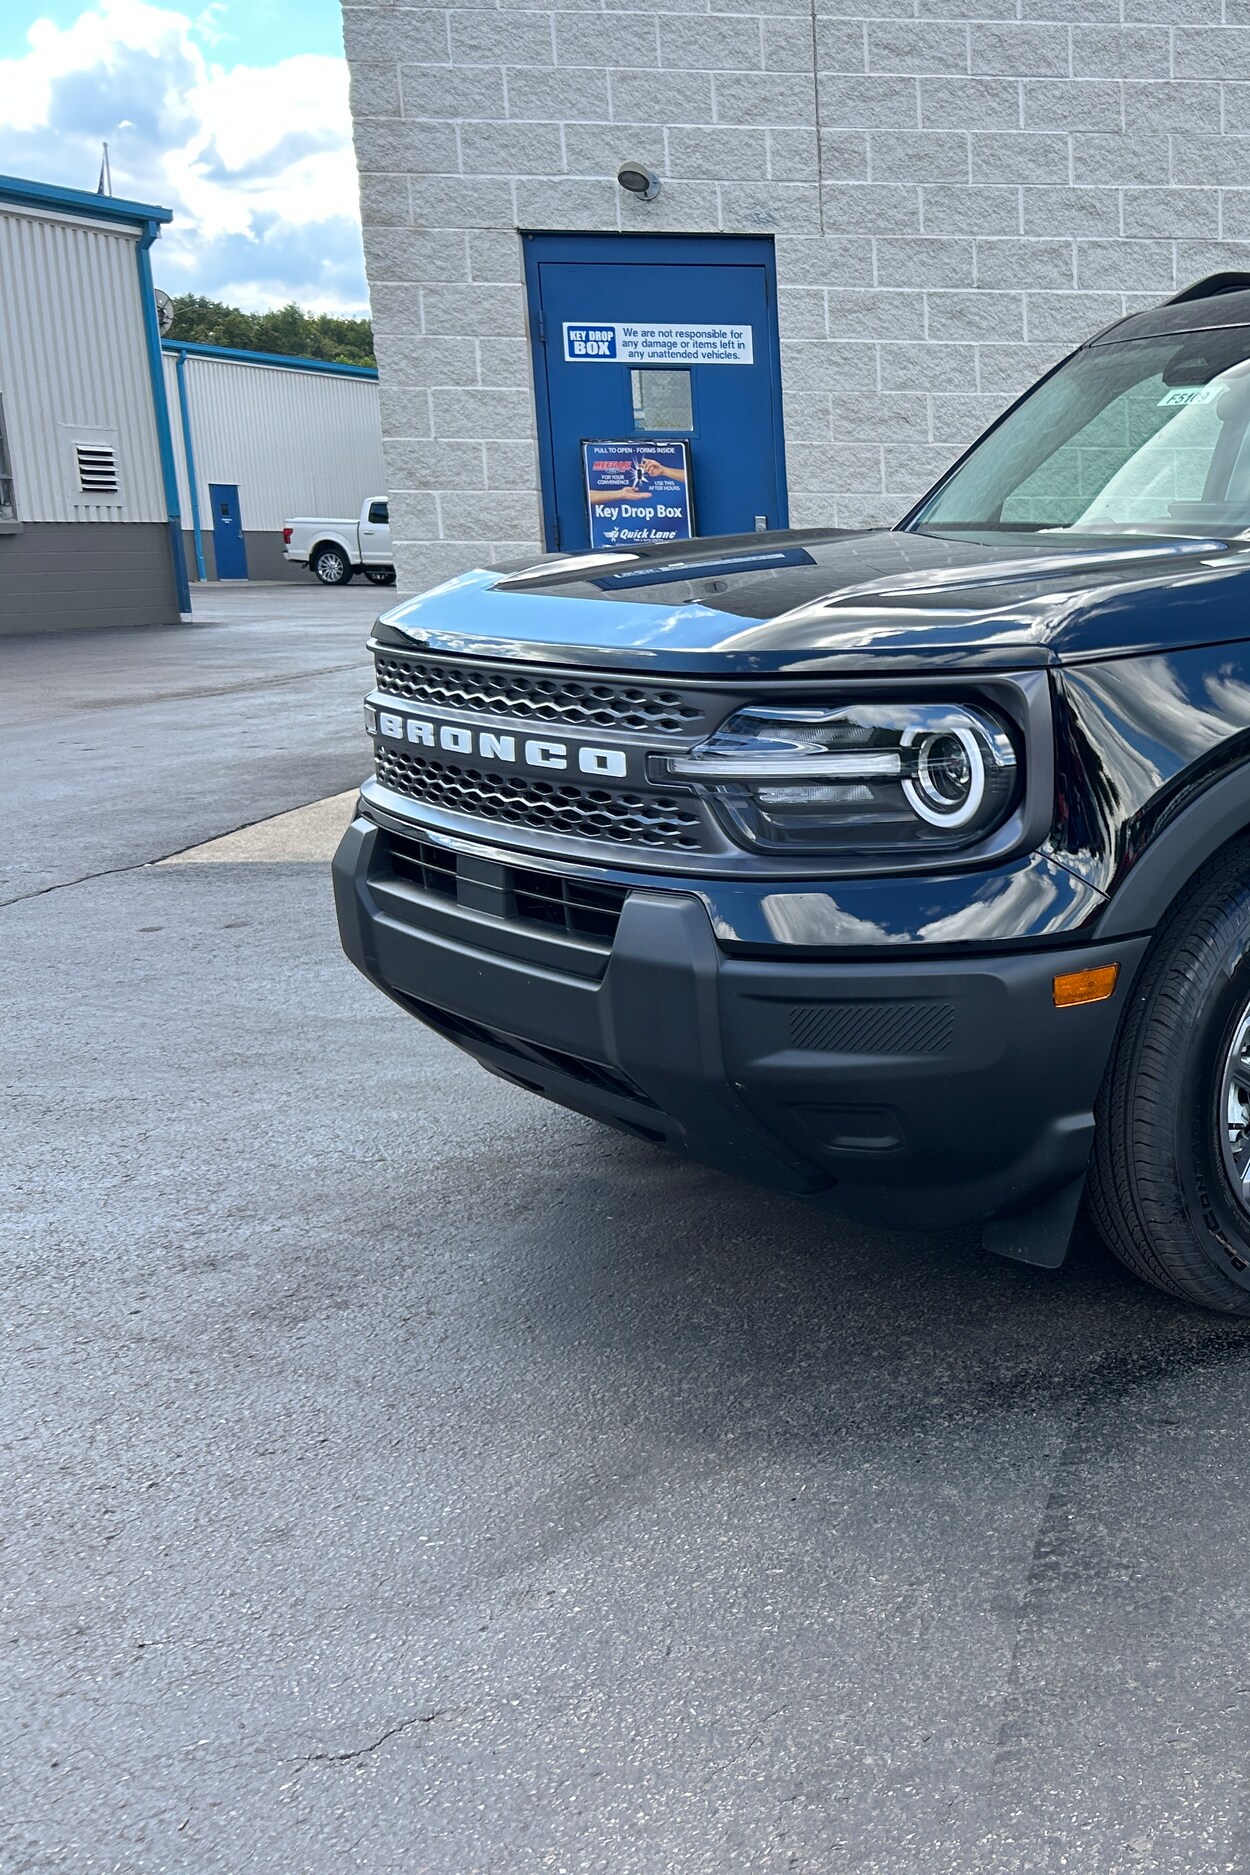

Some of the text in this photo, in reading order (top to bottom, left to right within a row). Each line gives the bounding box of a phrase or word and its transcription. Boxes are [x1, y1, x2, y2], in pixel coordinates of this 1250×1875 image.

[570, 331, 614, 342] KEY DROP
[623, 328, 743, 340] We are not responsible for
[574, 341, 610, 355] BOX
[622, 340, 639, 349] any
[641, 339, 678, 350] damage
[692, 340, 718, 349] items
[720, 340, 735, 349] left
[737, 341, 745, 350] in
[628, 348, 741, 360] any unattended vehicles.
[595, 505, 683, 520] Key Drop Box
[620, 528, 676, 540] Quick Lane
[380, 712, 628, 778] BRONCO
